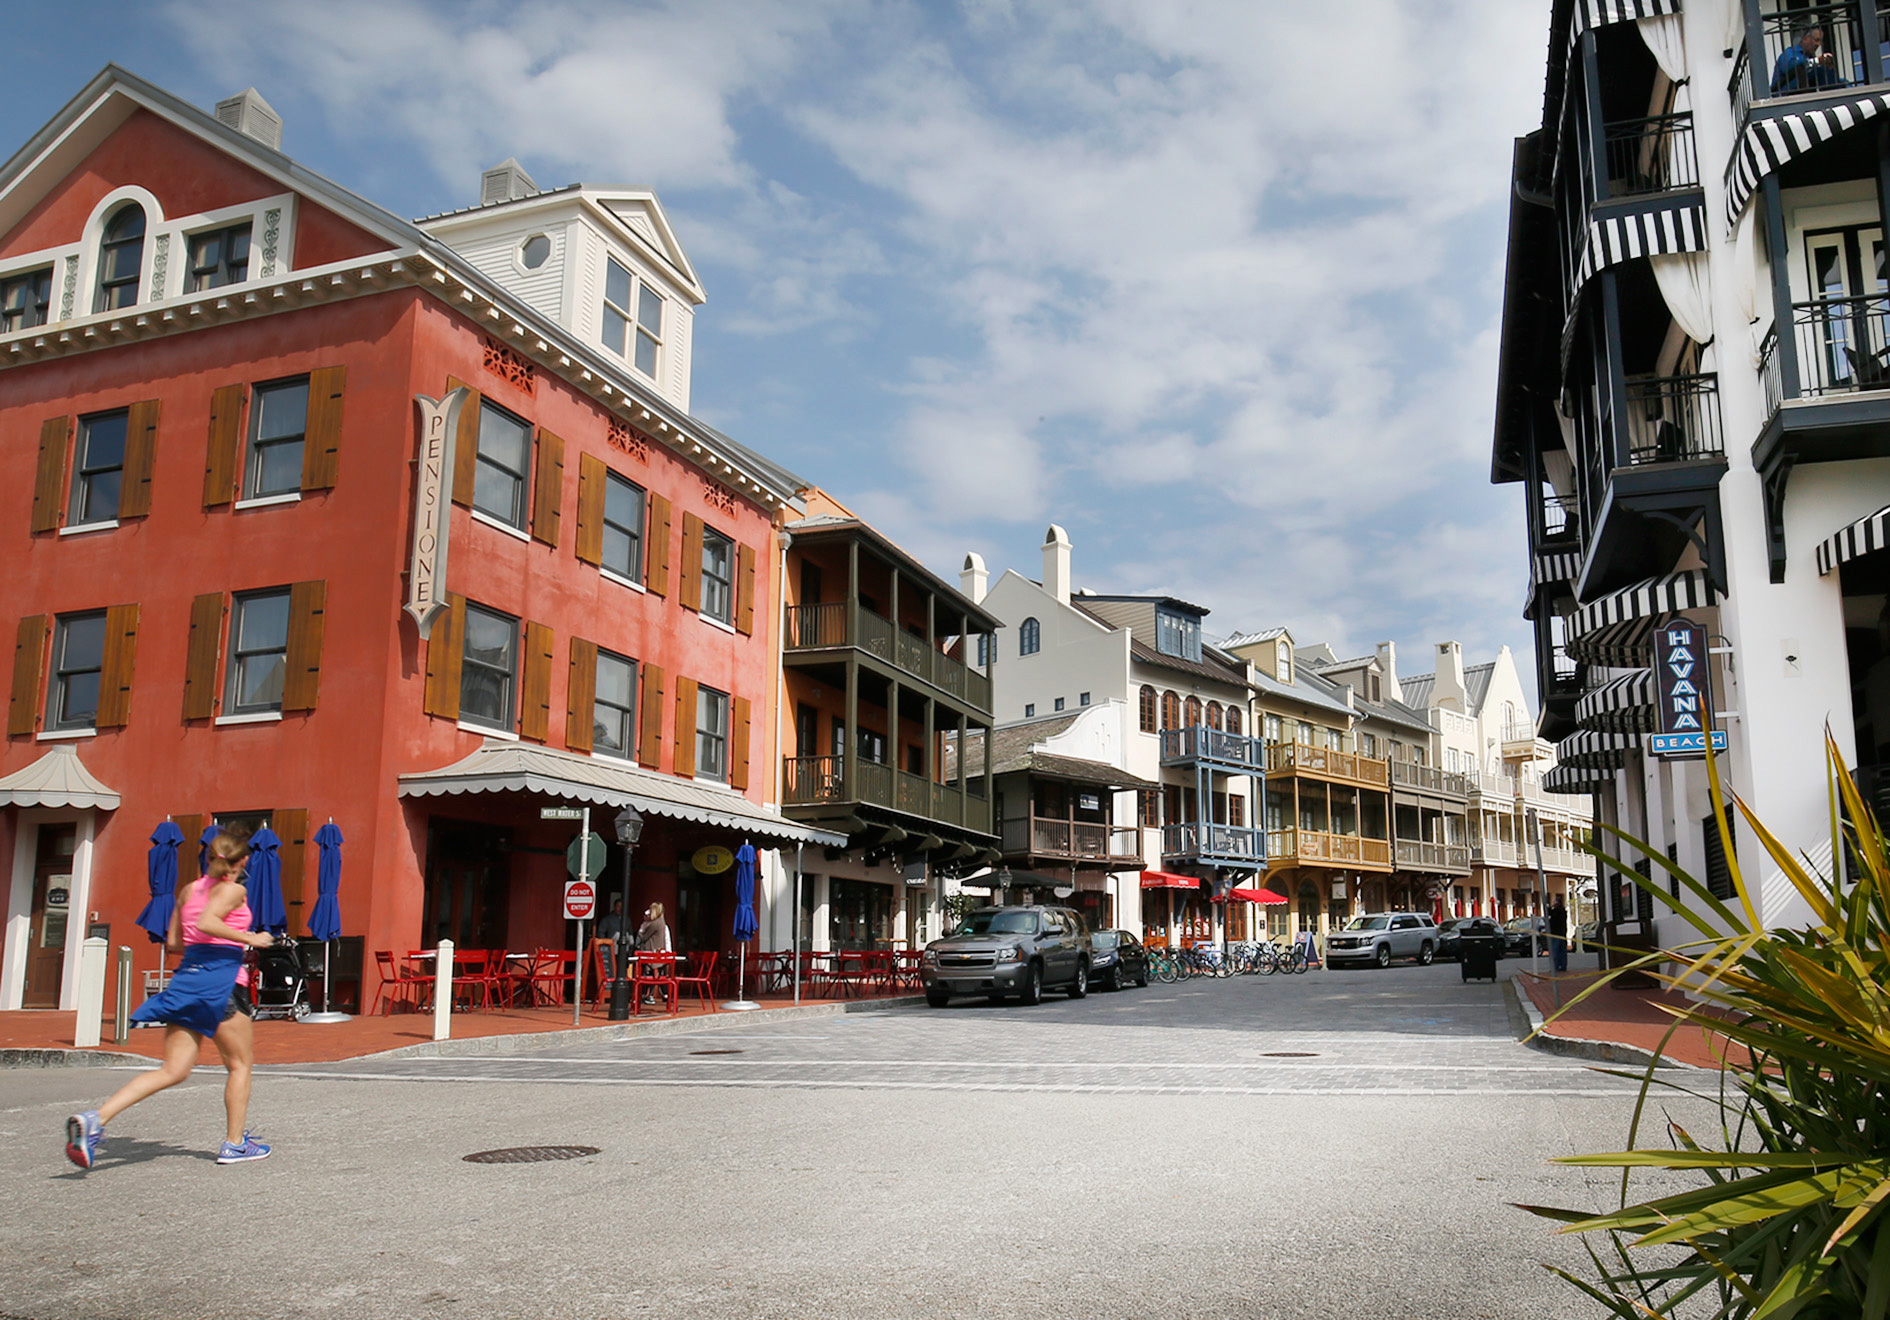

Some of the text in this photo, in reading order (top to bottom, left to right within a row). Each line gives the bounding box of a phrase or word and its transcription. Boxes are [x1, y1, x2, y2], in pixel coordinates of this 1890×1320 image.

[417, 415, 443, 603] PENSIONE
[1667, 629, 1700, 730] HAVANA
[1656, 736, 1722, 748] BEACH
[543, 809, 556, 817] WEST
[558, 809, 575, 817] WATER
